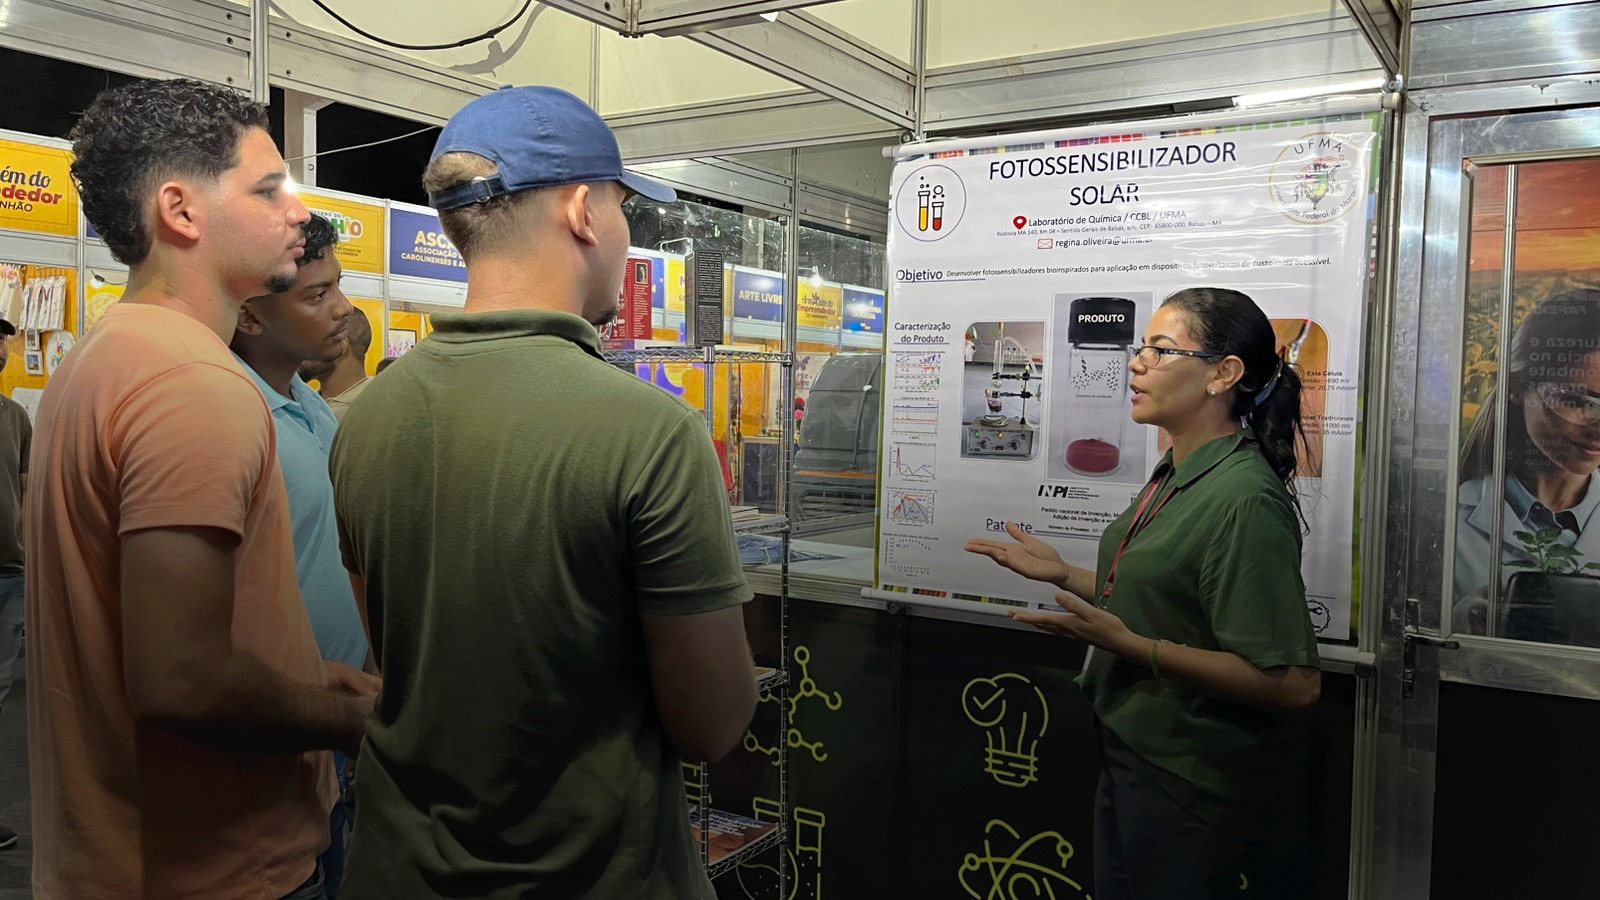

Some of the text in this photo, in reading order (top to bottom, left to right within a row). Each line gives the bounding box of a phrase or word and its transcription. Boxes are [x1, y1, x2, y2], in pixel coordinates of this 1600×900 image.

[1293, 138, 1342, 155] UFMA
[989, 141, 1237, 180] FOTOSSENSIBILIZADOR
[0, 165, 51, 188] ém do
[0, 184, 62, 205] dedor
[1069, 183, 1139, 206] SOLAR
[0, 201, 33, 212] NHÃO
[1028, 217, 1075, 227] Laboratório
[1088, 214, 1121, 225] Química
[1130, 213, 1151, 221] CCBL
[401, 252, 452, 266] CAROLINENSES
[414, 246, 458, 259] ASSOCIAÇÃO
[895, 269, 944, 283] Objetivo
[946, 270, 981, 278] Desenvolver
[1106, 264, 1138, 273] aplicação
[738, 289, 760, 302] ARTE
[1078, 314, 1125, 323] PRODUTO
[894, 321, 951, 332] Caracterização
[901, 334, 945, 343] do Produto
[1038, 484, 1069, 498] INPI
[1041, 506, 1058, 514] Pedido
